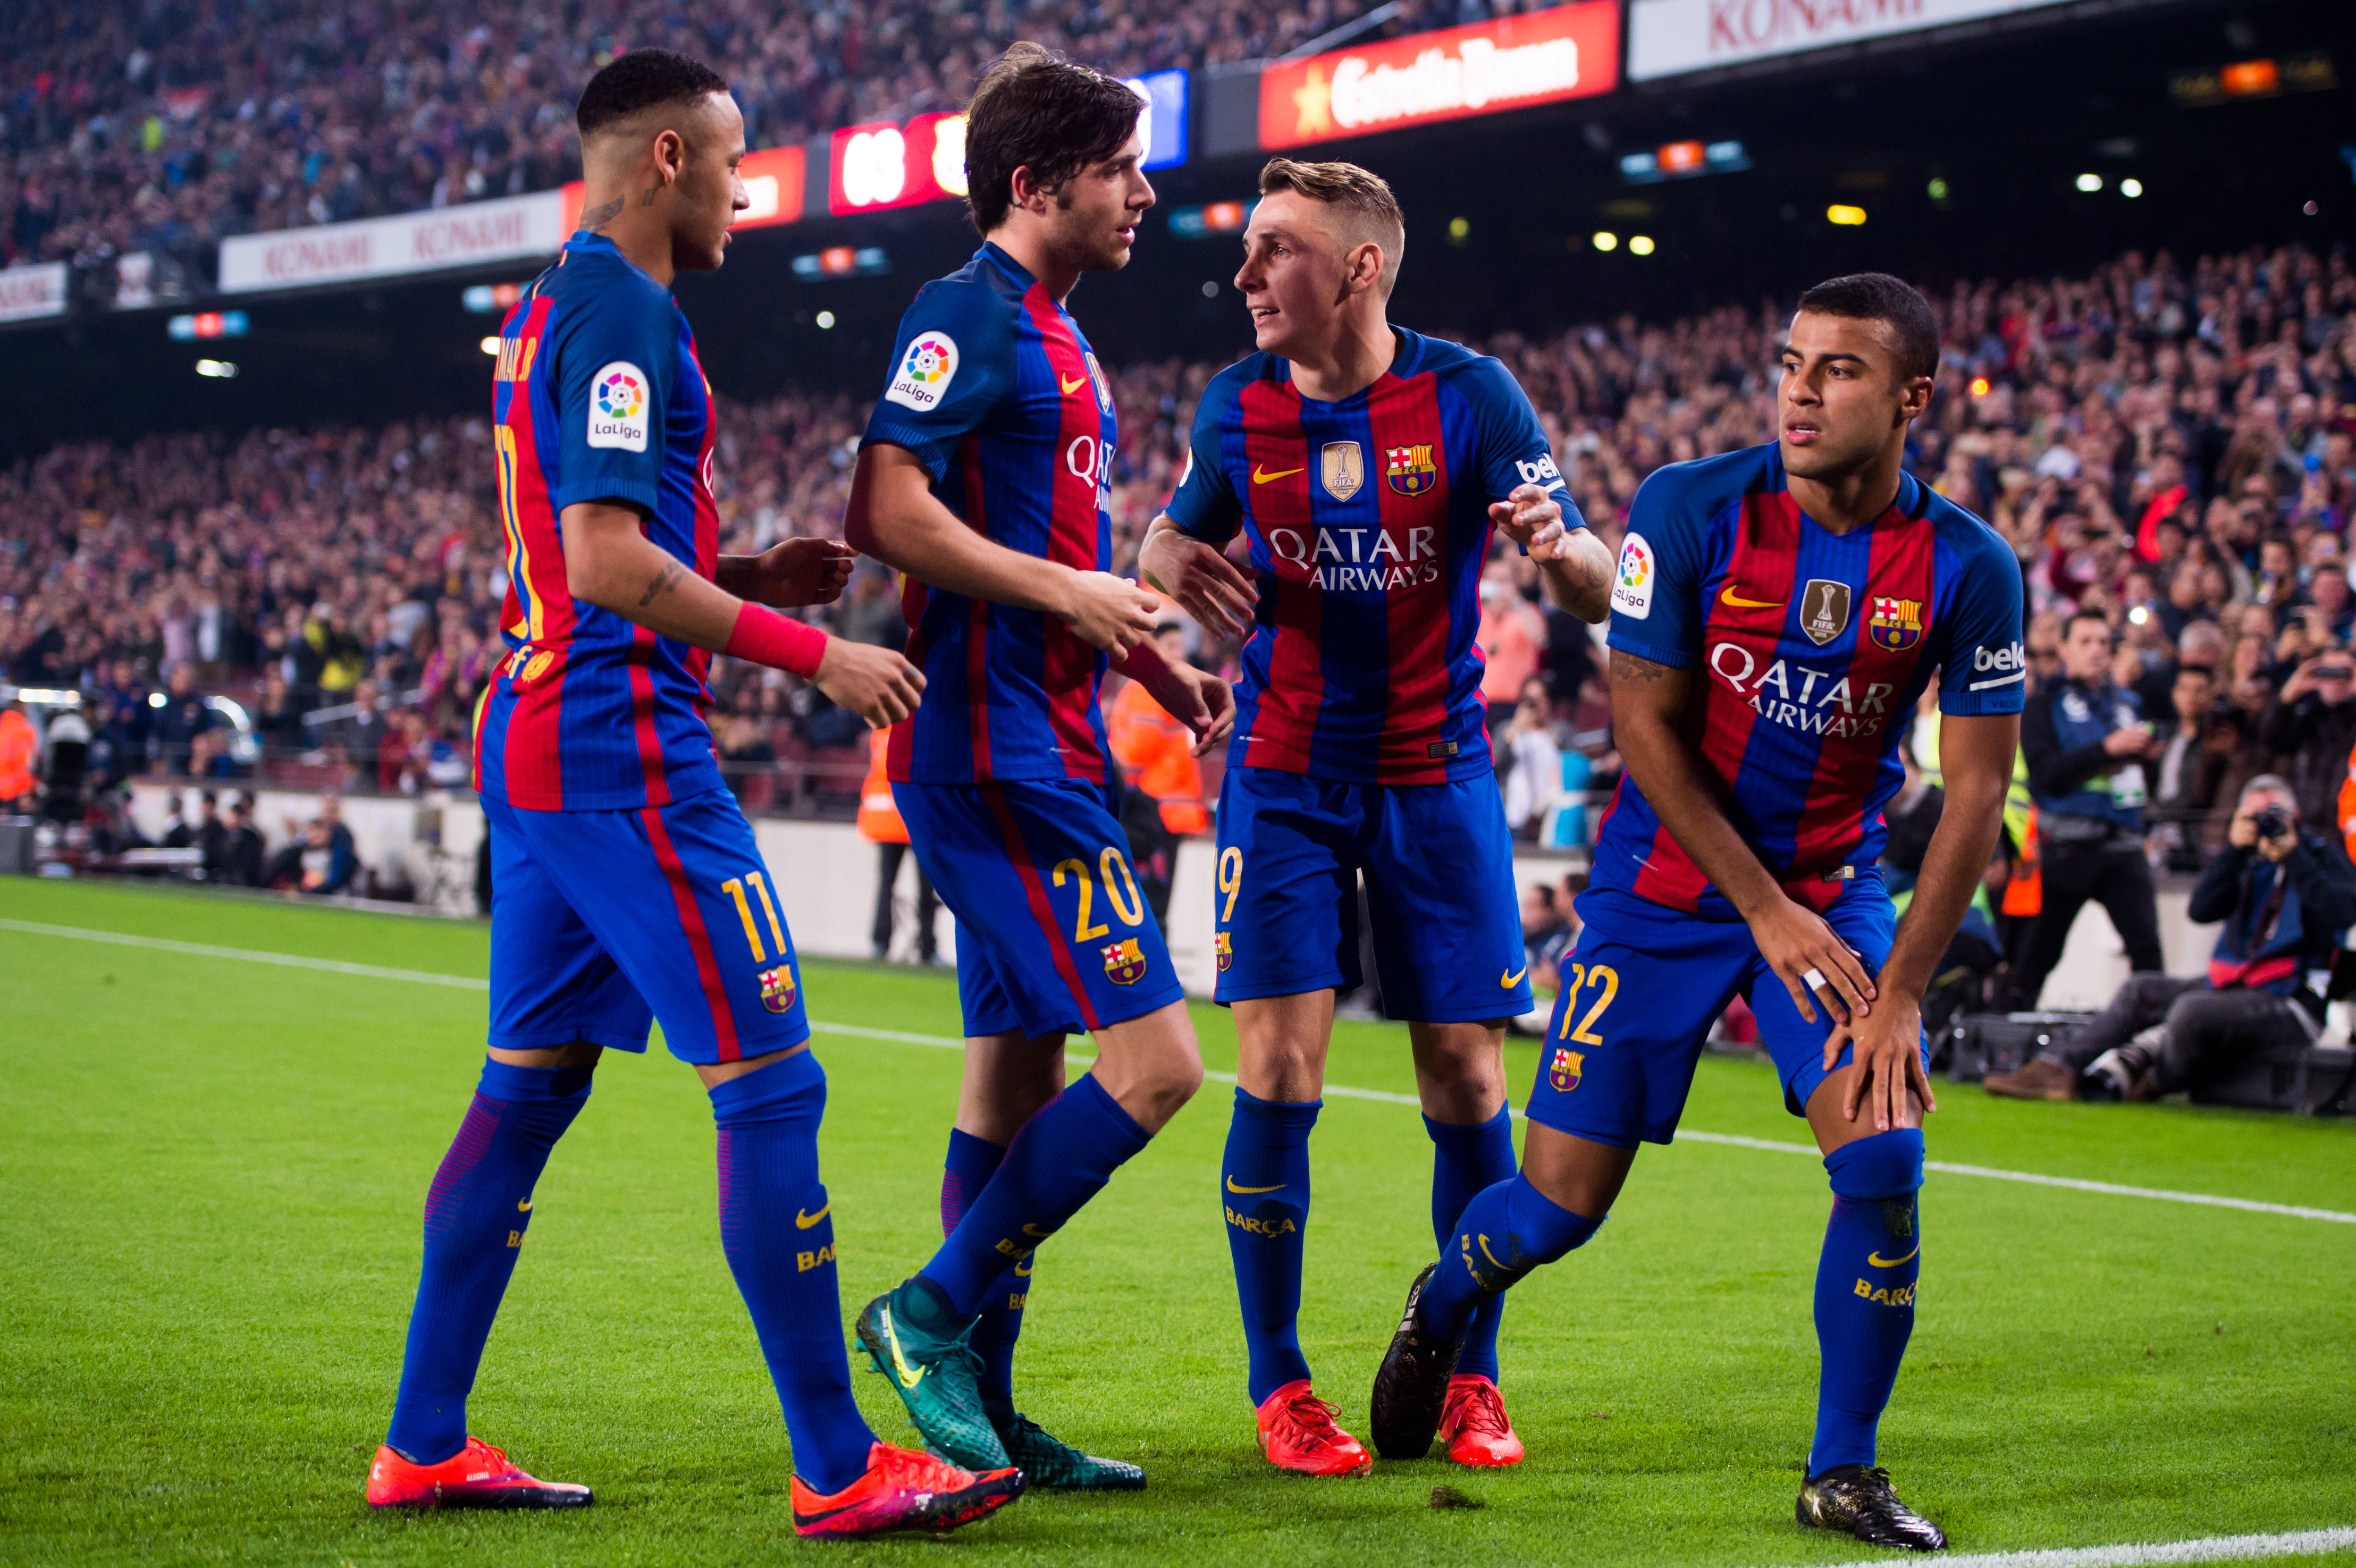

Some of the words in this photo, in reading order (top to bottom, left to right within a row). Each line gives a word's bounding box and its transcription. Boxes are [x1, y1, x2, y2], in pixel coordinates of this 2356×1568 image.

[894, 381, 934, 403] LaLiga
[595, 422, 641, 439] LaLiga
[1333, 478, 1352, 487] FIFA
[1269, 526, 1437, 571] QATAR
[1308, 560, 1438, 591] AIRWAYS
[1614, 584, 1644, 607] LaLiga
[1812, 619, 1833, 630] FIFA
[1974, 641, 2025, 671] bek
[1711, 642, 1893, 714] QATAR
[1747, 694, 1882, 738] AIRWAYS
[1053, 846, 1144, 943] 20
[721, 871, 787, 964] 11
[1559, 963, 1619, 1047] 12
[1226, 1205, 1295, 1238] BARÇA
